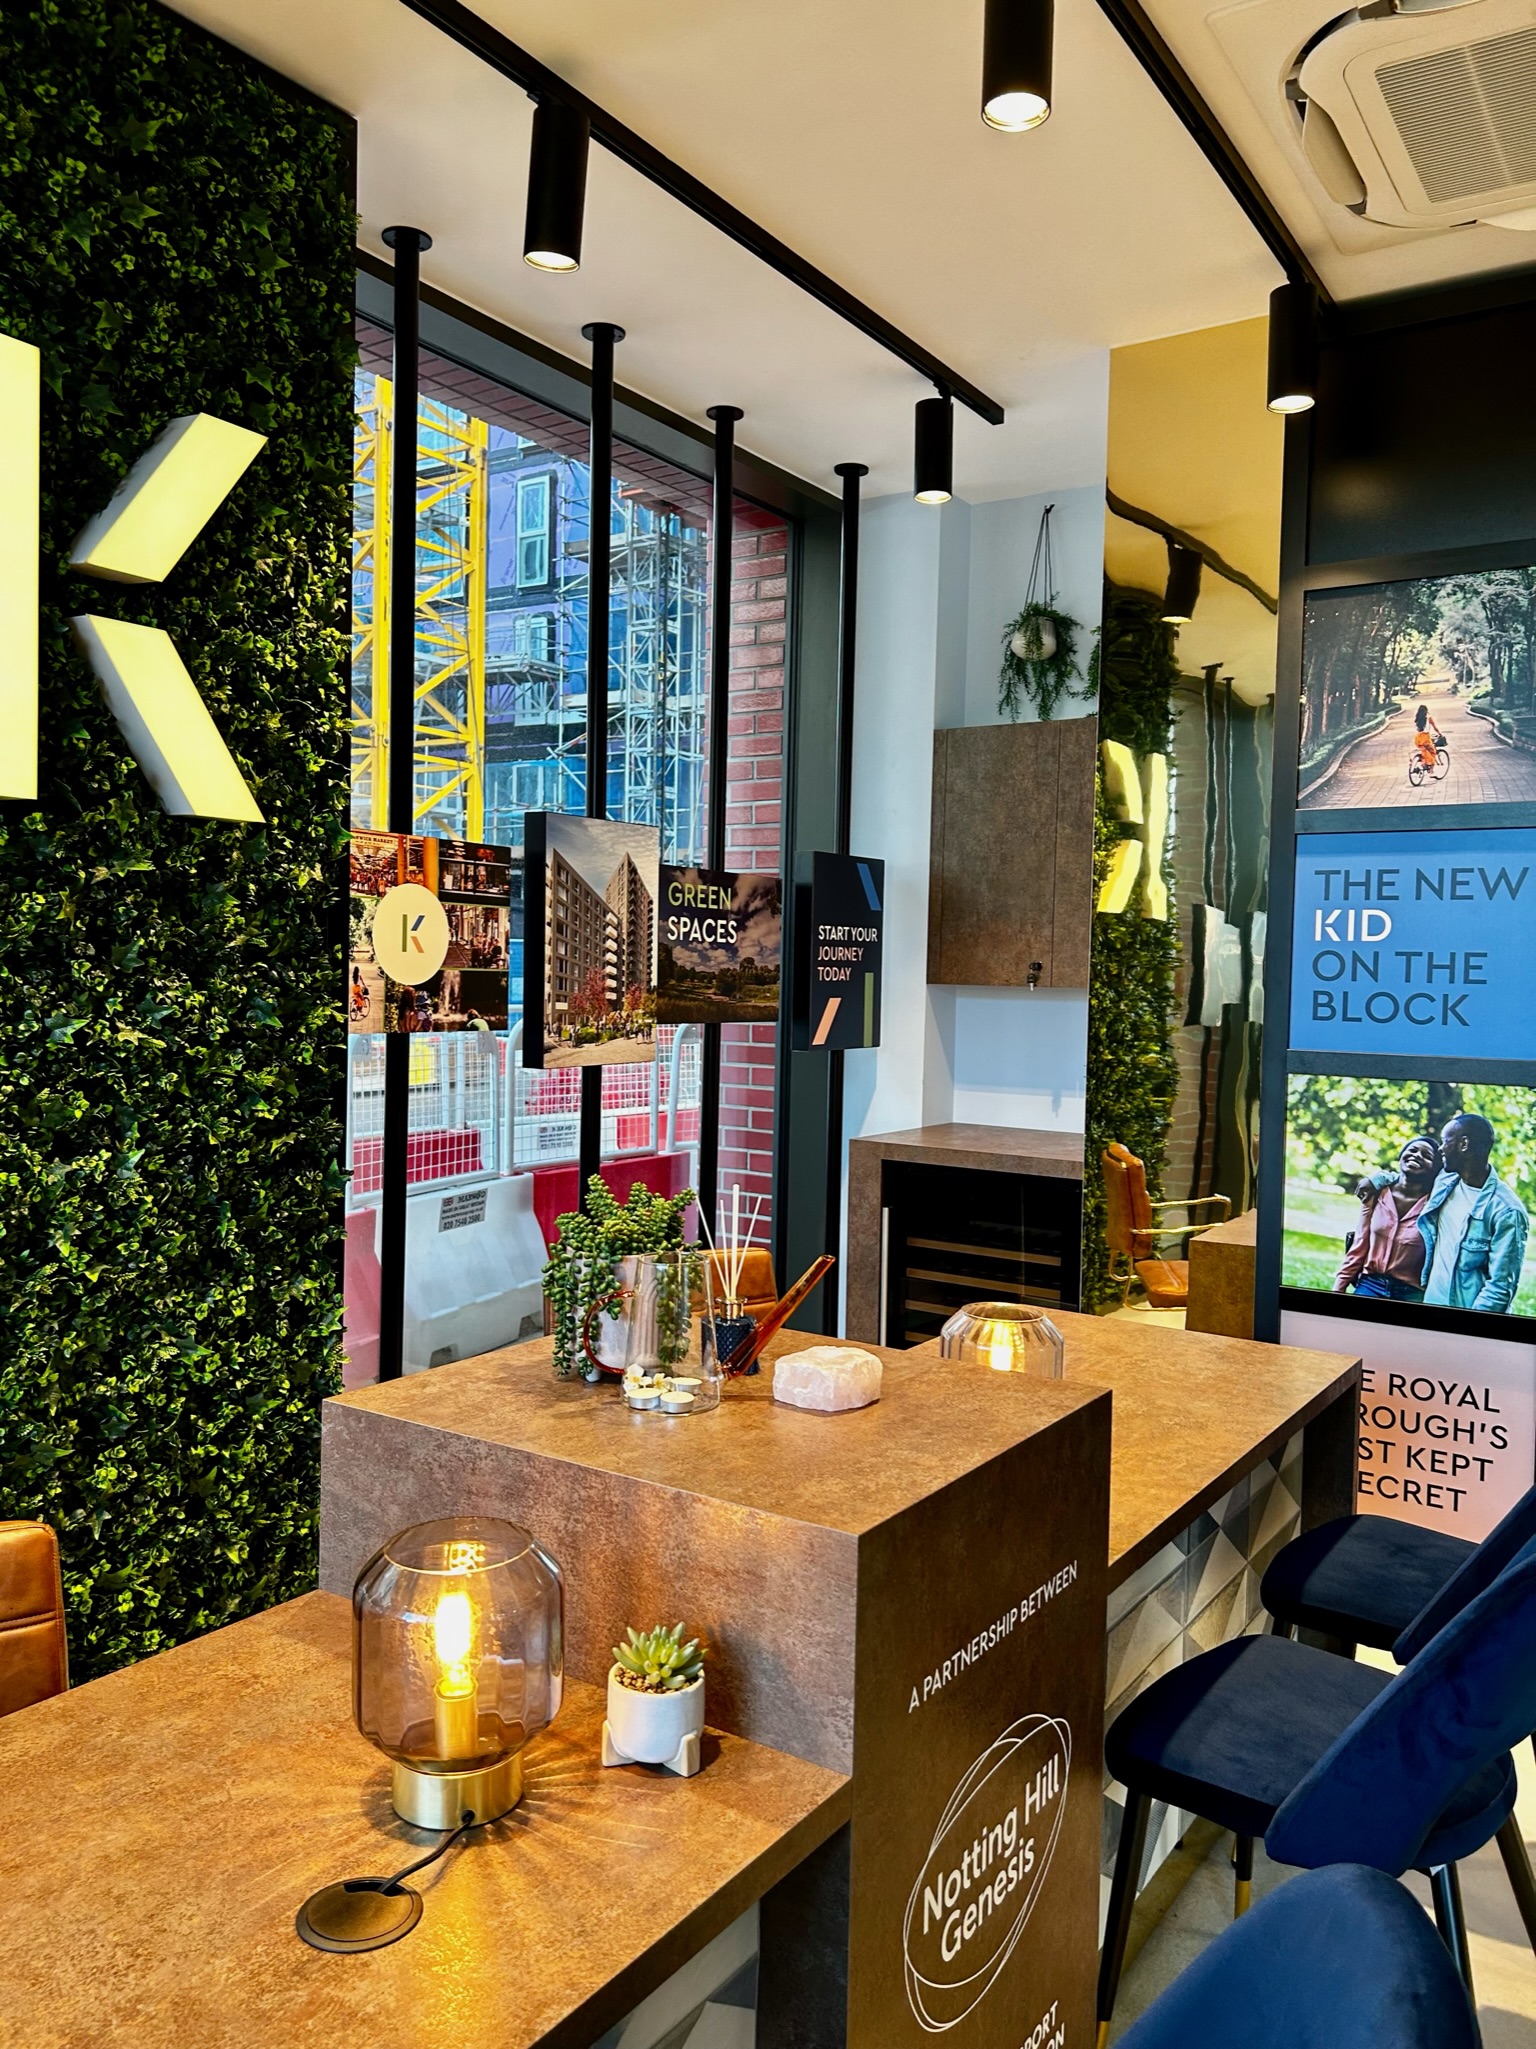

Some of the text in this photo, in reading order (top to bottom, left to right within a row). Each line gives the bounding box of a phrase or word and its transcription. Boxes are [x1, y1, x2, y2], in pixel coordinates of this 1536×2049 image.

[668, 882, 732, 910] GREEN
[1314, 867, 1529, 901] THE NEW
[402, 914, 426, 953] K
[667, 916, 737, 944] SPACES
[818, 925, 878, 943] START YOUR
[1314, 909, 1392, 942] KID
[817, 946, 864, 962] JOURNEY
[1312, 950, 1488, 985] ON THE
[817, 966, 852, 981] TODAY
[1312, 990, 1470, 1026] BLOCK
[1389, 1373, 1500, 1413] ROYAL
[1359, 1403, 1508, 1450] ROUGH'S
[1358, 1437, 1493, 1482] ST KEPT
[1358, 1471, 1467, 1512] ECRET
[908, 1560, 1078, 1713] A PARTNERSHIP BETWEEN
[923, 1753, 1059, 1935] Notting Hill
[940, 1838, 1035, 1963] Genesis
[1021, 2000, 1058, 2049] PORT
